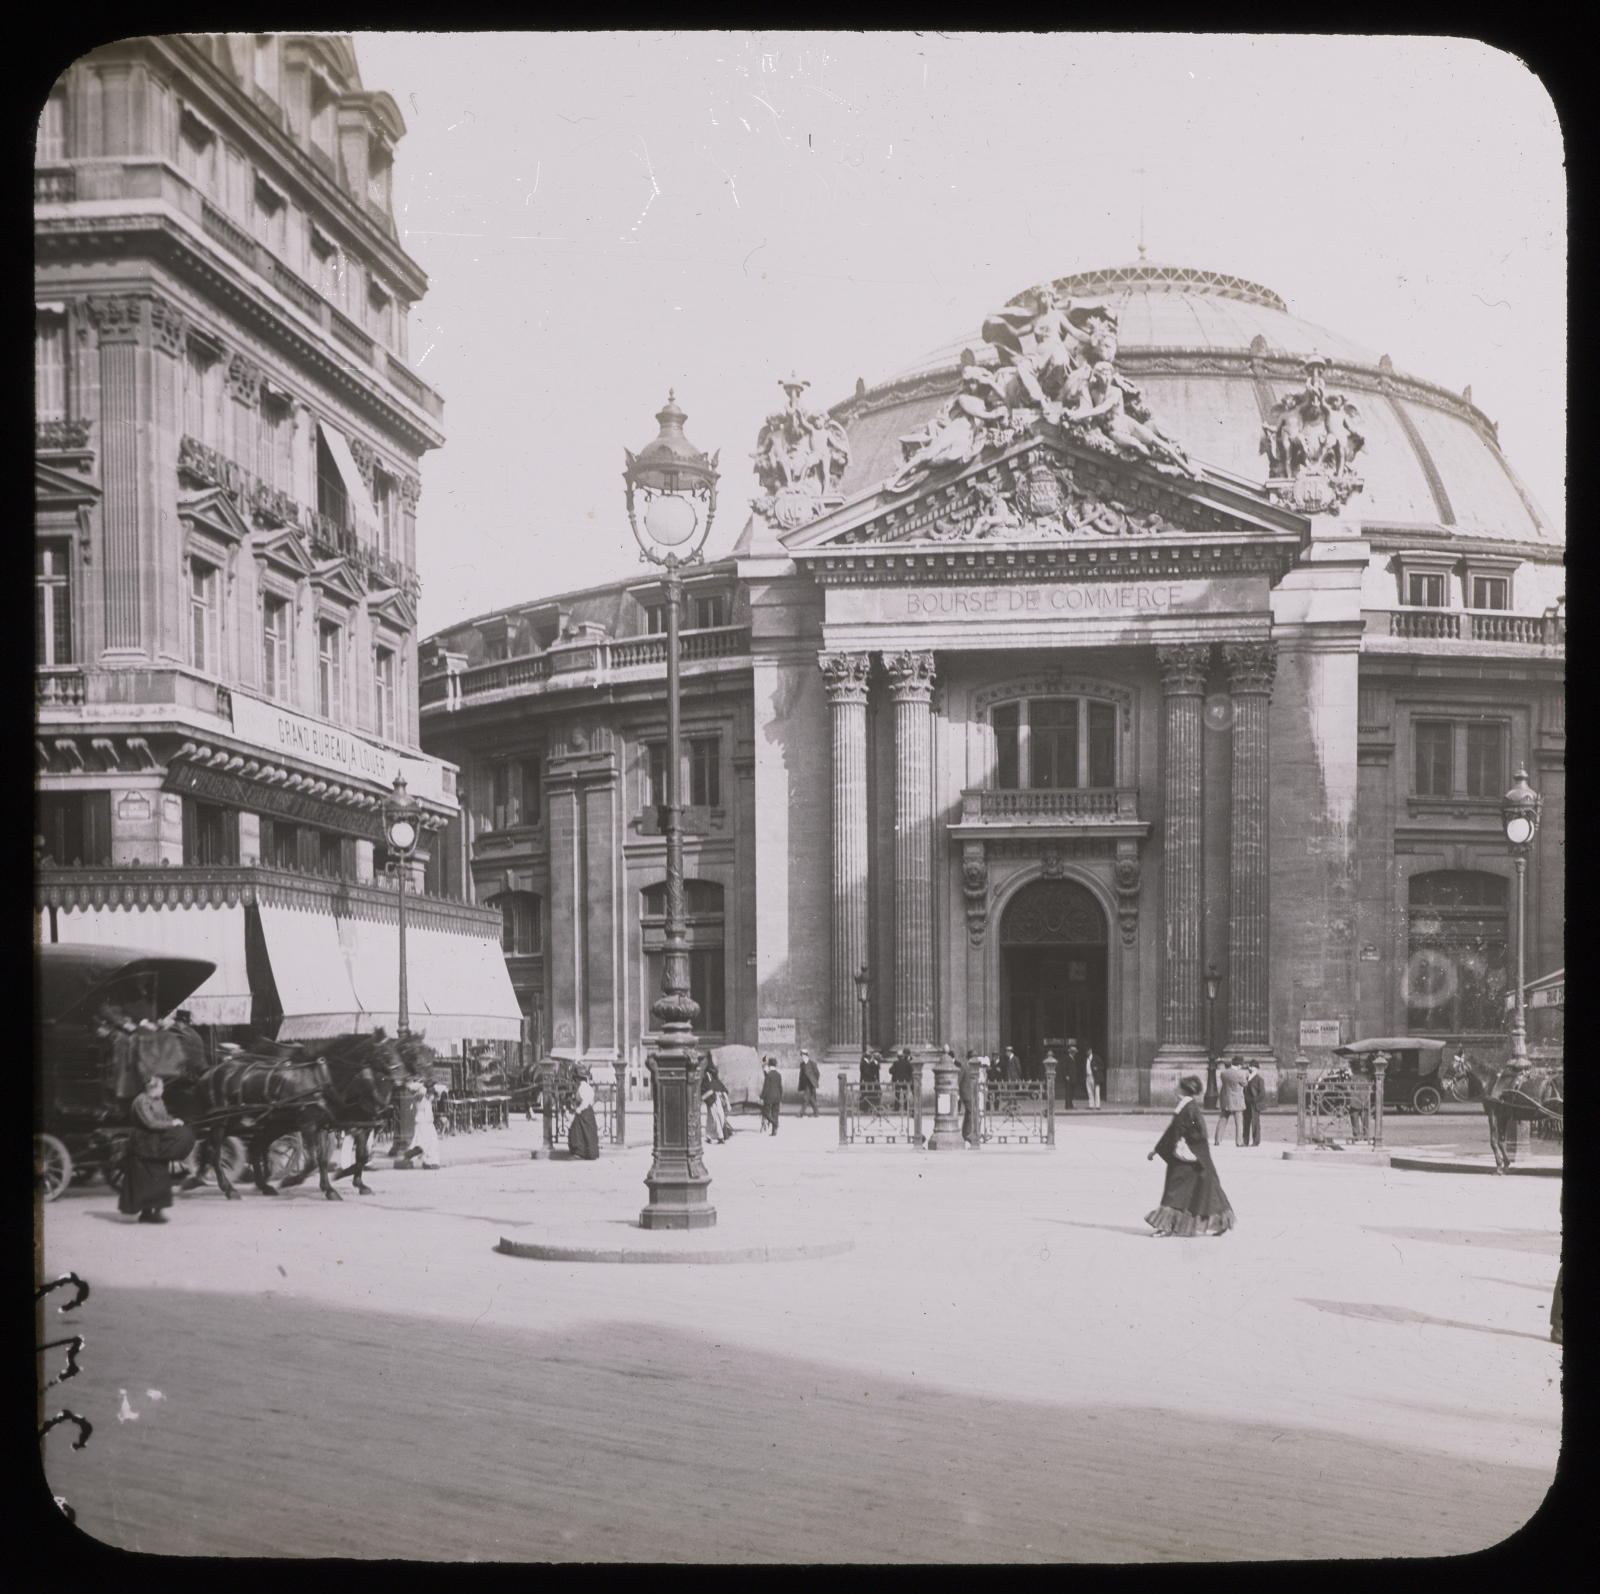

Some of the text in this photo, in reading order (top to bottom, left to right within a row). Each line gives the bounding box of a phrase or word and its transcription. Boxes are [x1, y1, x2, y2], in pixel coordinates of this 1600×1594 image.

[907, 585, 1184, 614] BOURSE DE COMMERCE
[278, 717, 310, 752] GRAND
[313, 729, 347, 764] BUREAU
[361, 748, 385, 778] LOUER
